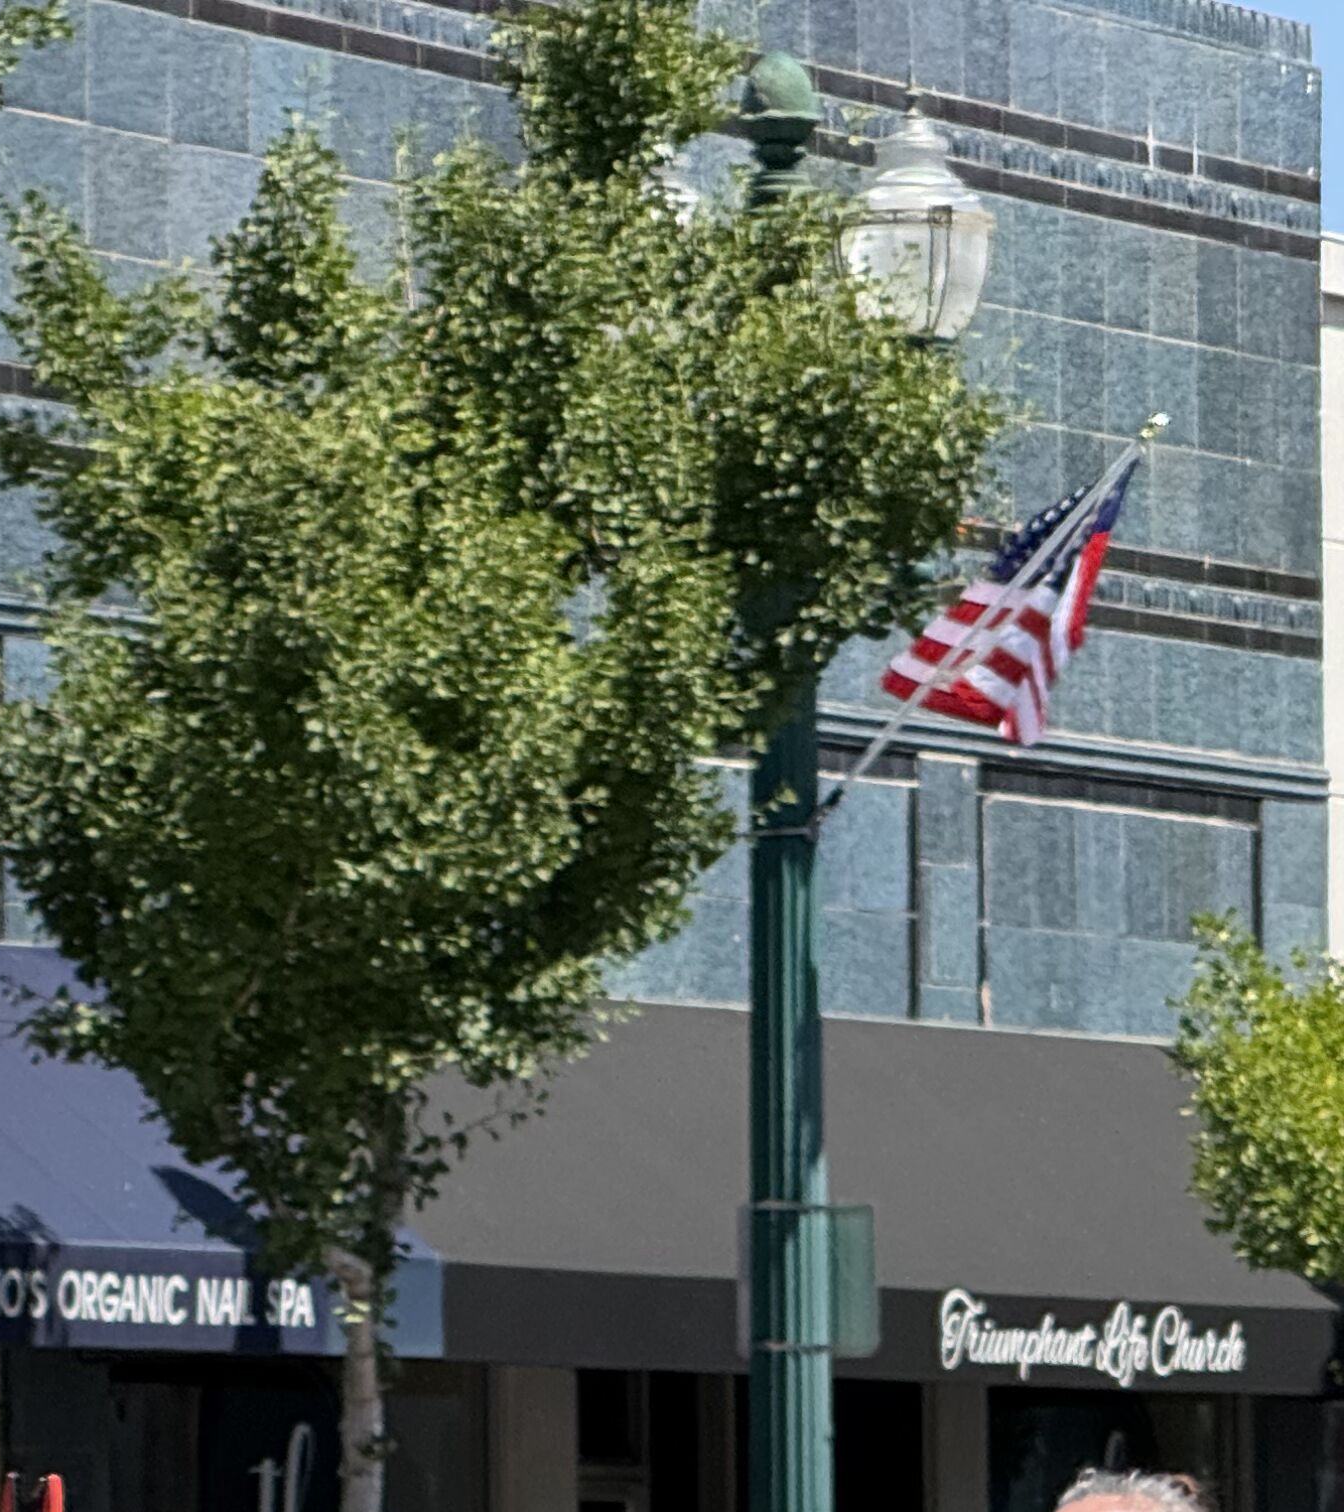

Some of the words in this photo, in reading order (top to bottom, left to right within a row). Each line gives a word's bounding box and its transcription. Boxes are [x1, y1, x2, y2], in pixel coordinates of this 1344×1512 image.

[56, 1269, 189, 1326] ORGANIC
[196, 1276, 258, 1326] NAIL
[266, 1278, 316, 1328] SPA
[941, 1288, 1097, 1381] Triumphant
[1095, 1301, 1149, 1388] Life
[1150, 1305, 1247, 1377] Church
